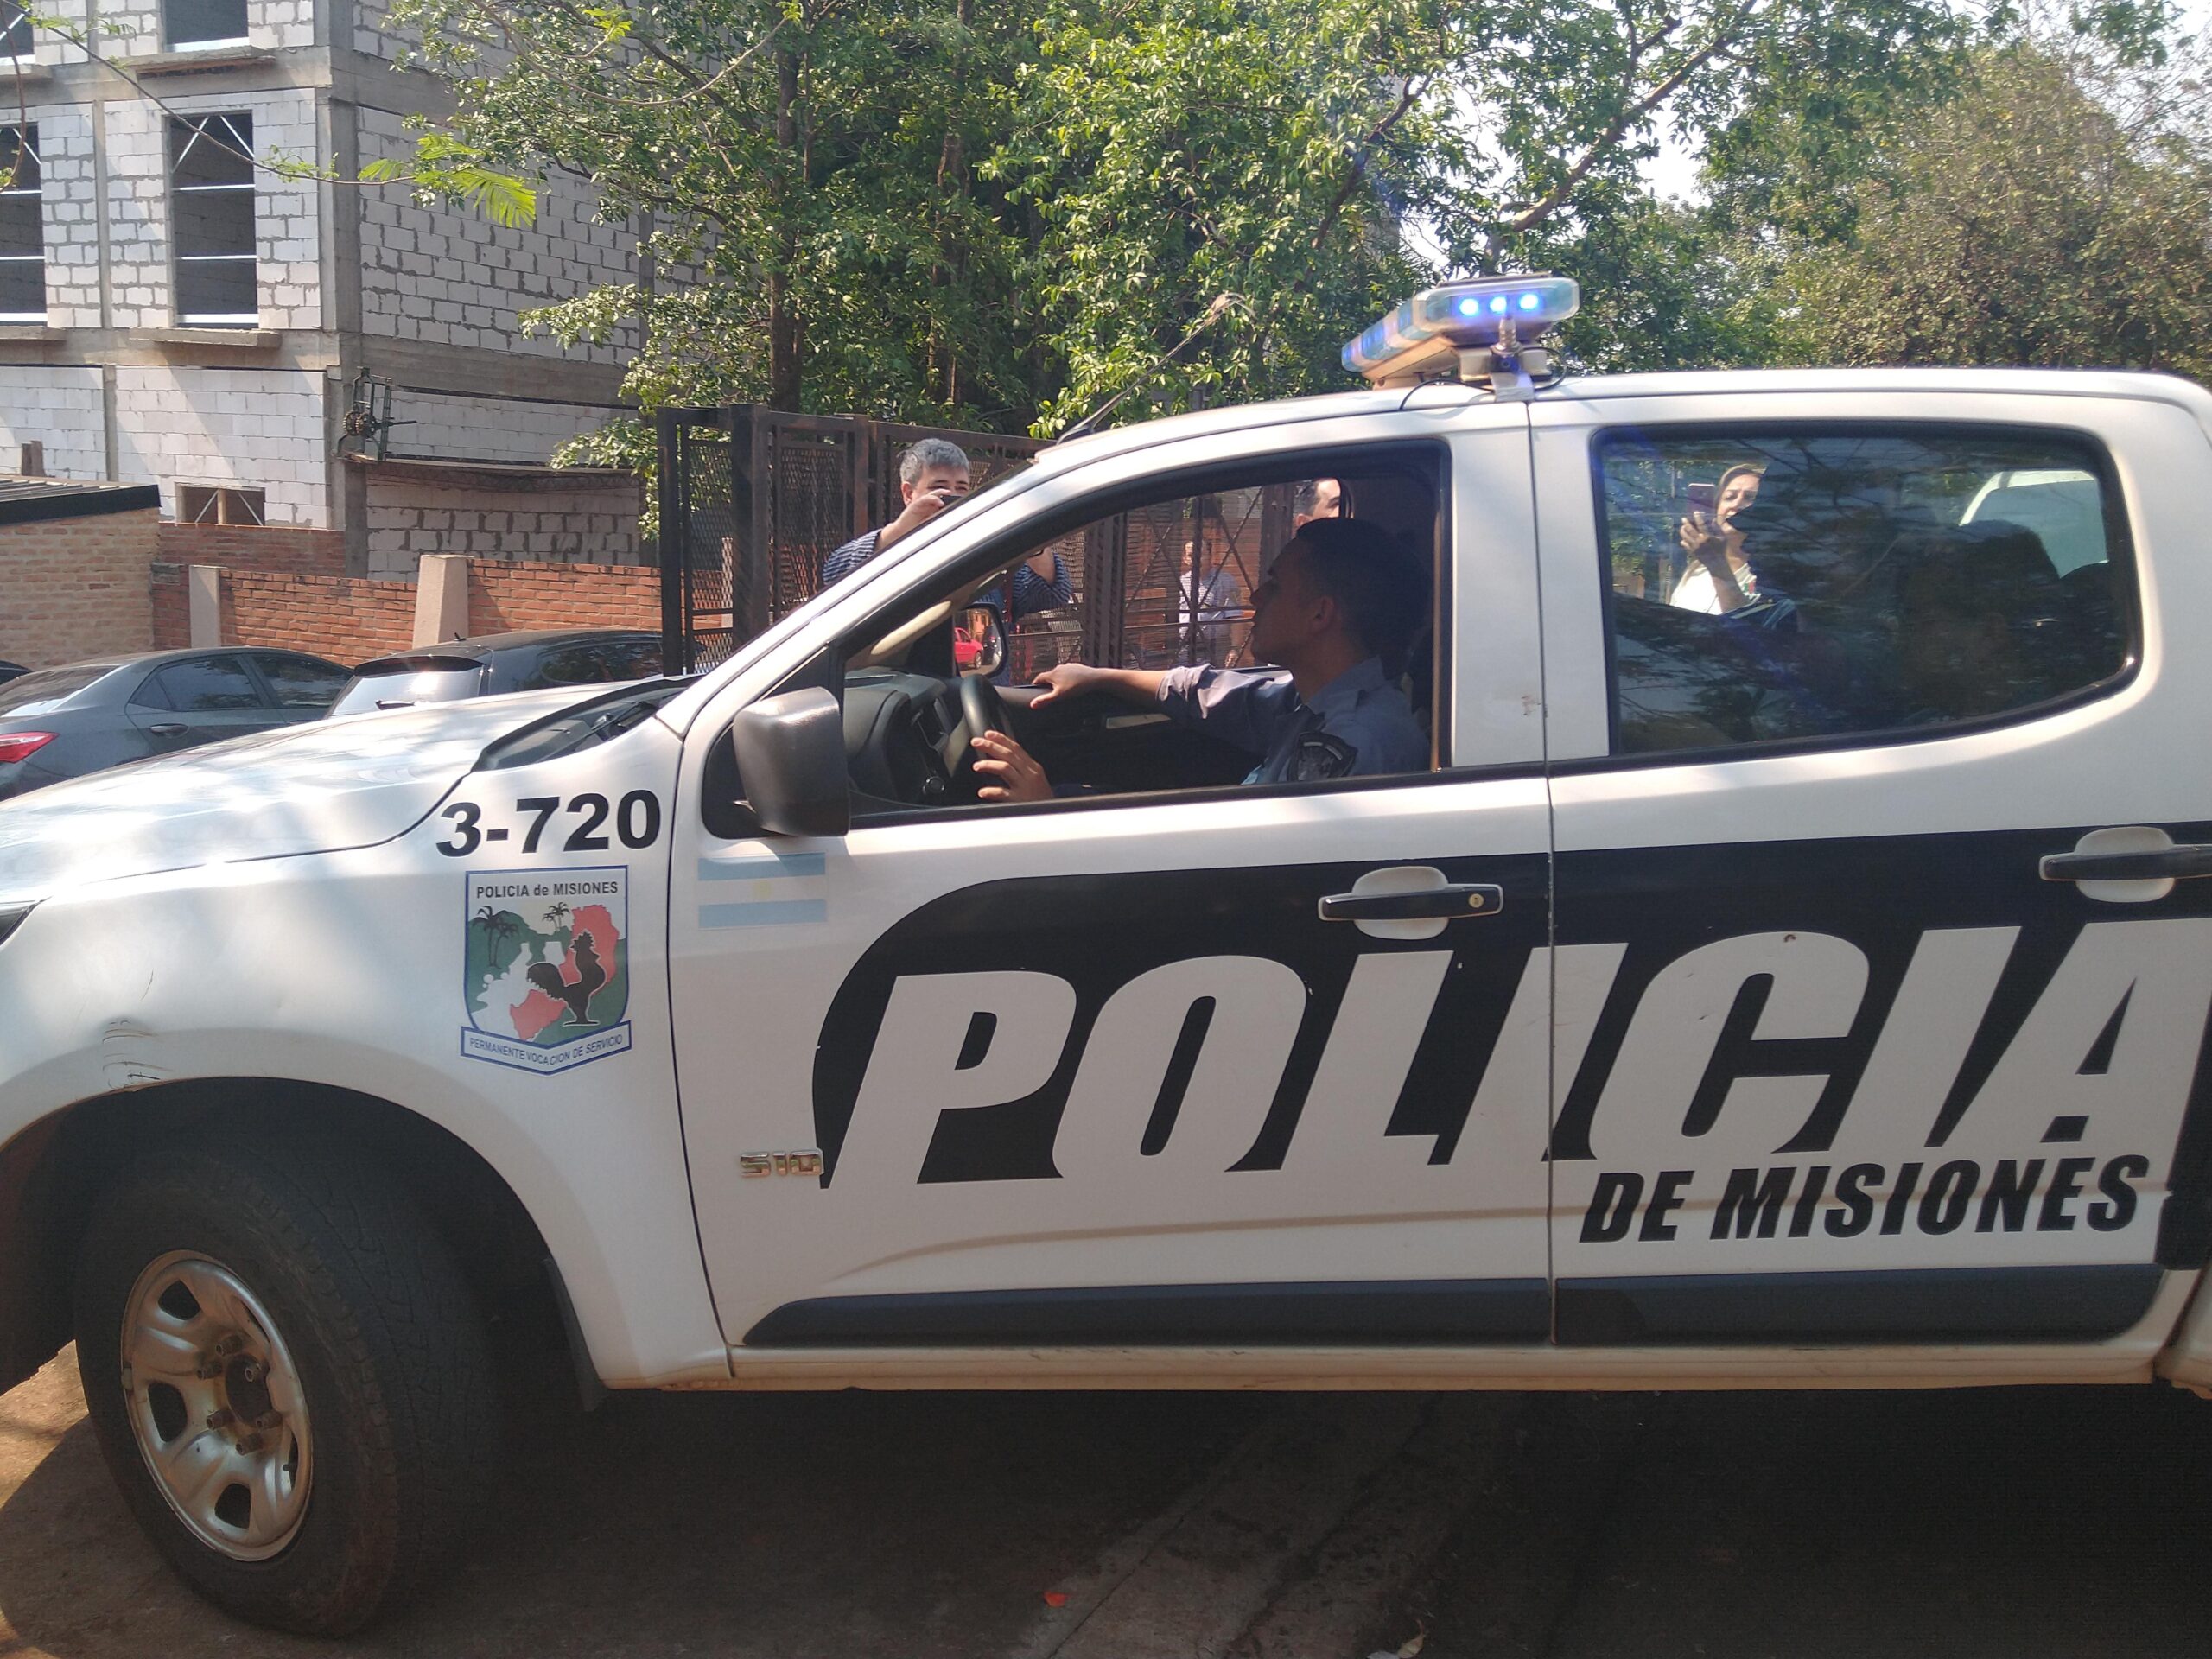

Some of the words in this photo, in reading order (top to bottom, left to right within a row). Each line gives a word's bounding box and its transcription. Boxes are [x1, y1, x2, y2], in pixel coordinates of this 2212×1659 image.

[435, 790, 660, 857] 3-720
[476, 885, 530, 899] POLICIA
[533, 884, 550, 896] de
[553, 881, 619, 896] MISIONES
[469, 1037, 525, 1060] PERMANENTE
[572, 1047, 584, 1058] DE
[585, 1034, 623, 1054] SERVICIO
[828, 918, 2212, 1190] POLICIA
[740, 1148, 823, 1178] S10
[1579, 1170, 1694, 1243] DE
[1709, 1154, 2151, 1241] MISIONES
